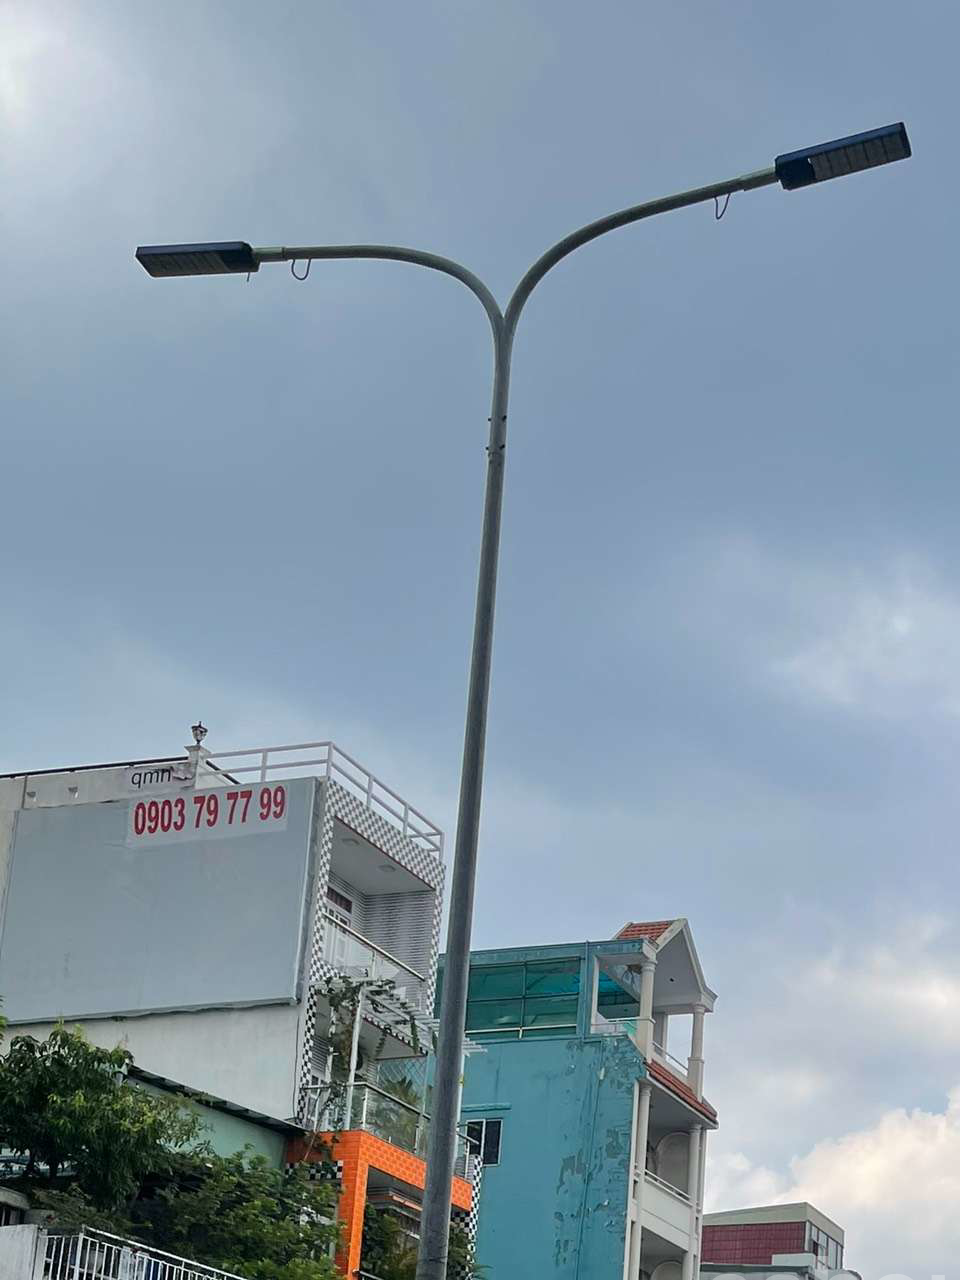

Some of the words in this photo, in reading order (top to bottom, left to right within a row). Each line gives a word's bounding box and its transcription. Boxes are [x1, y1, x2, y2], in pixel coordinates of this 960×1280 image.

[134, 798, 185, 835] 0903
[194, 794, 218, 828] 79
[227, 790, 252, 824] 77
[260, 786, 285, 820] 99
